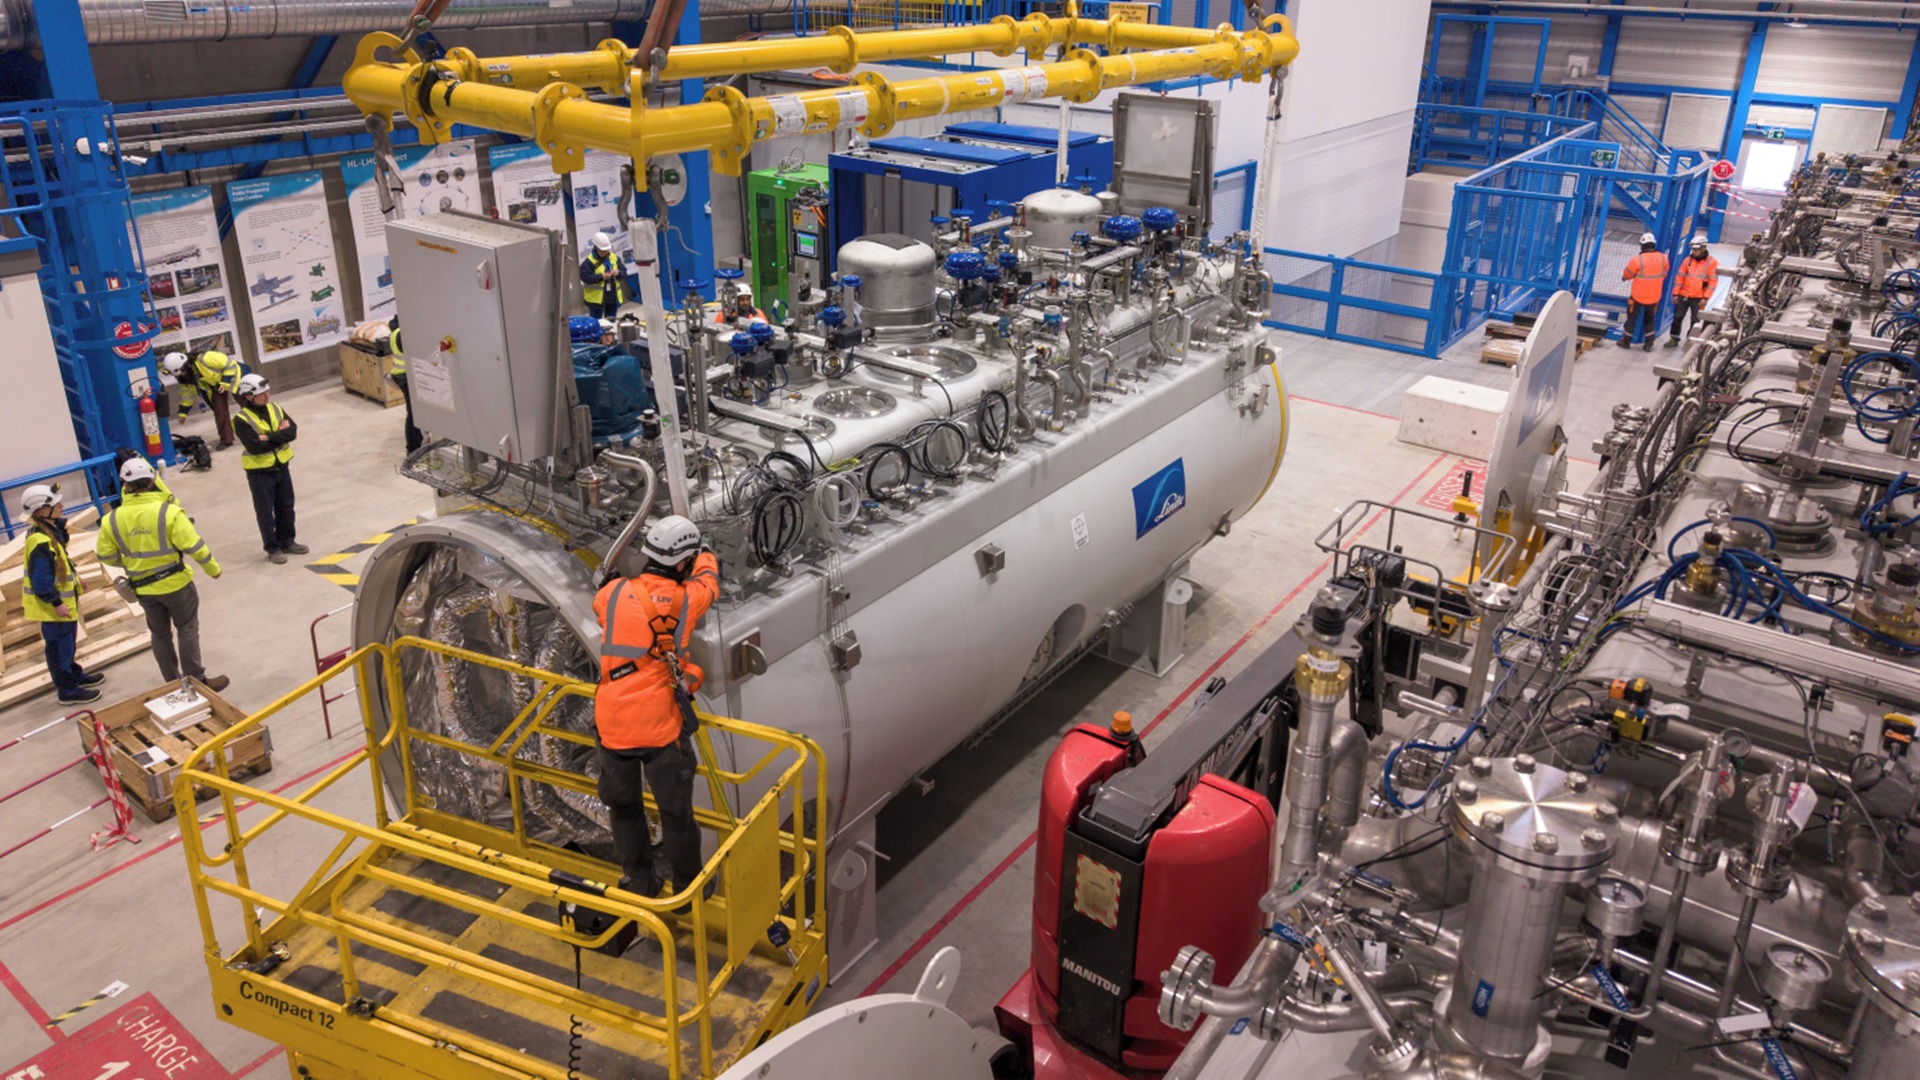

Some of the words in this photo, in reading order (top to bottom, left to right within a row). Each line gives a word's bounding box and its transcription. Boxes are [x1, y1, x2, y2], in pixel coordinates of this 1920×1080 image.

[1154, 493, 1184, 522] Linde
[1062, 957, 1121, 996] MANITOU
[240, 981, 314, 1023] Compact
[319, 1012, 335, 1030] 12
[117, 1005, 199, 1080] CHARGE
